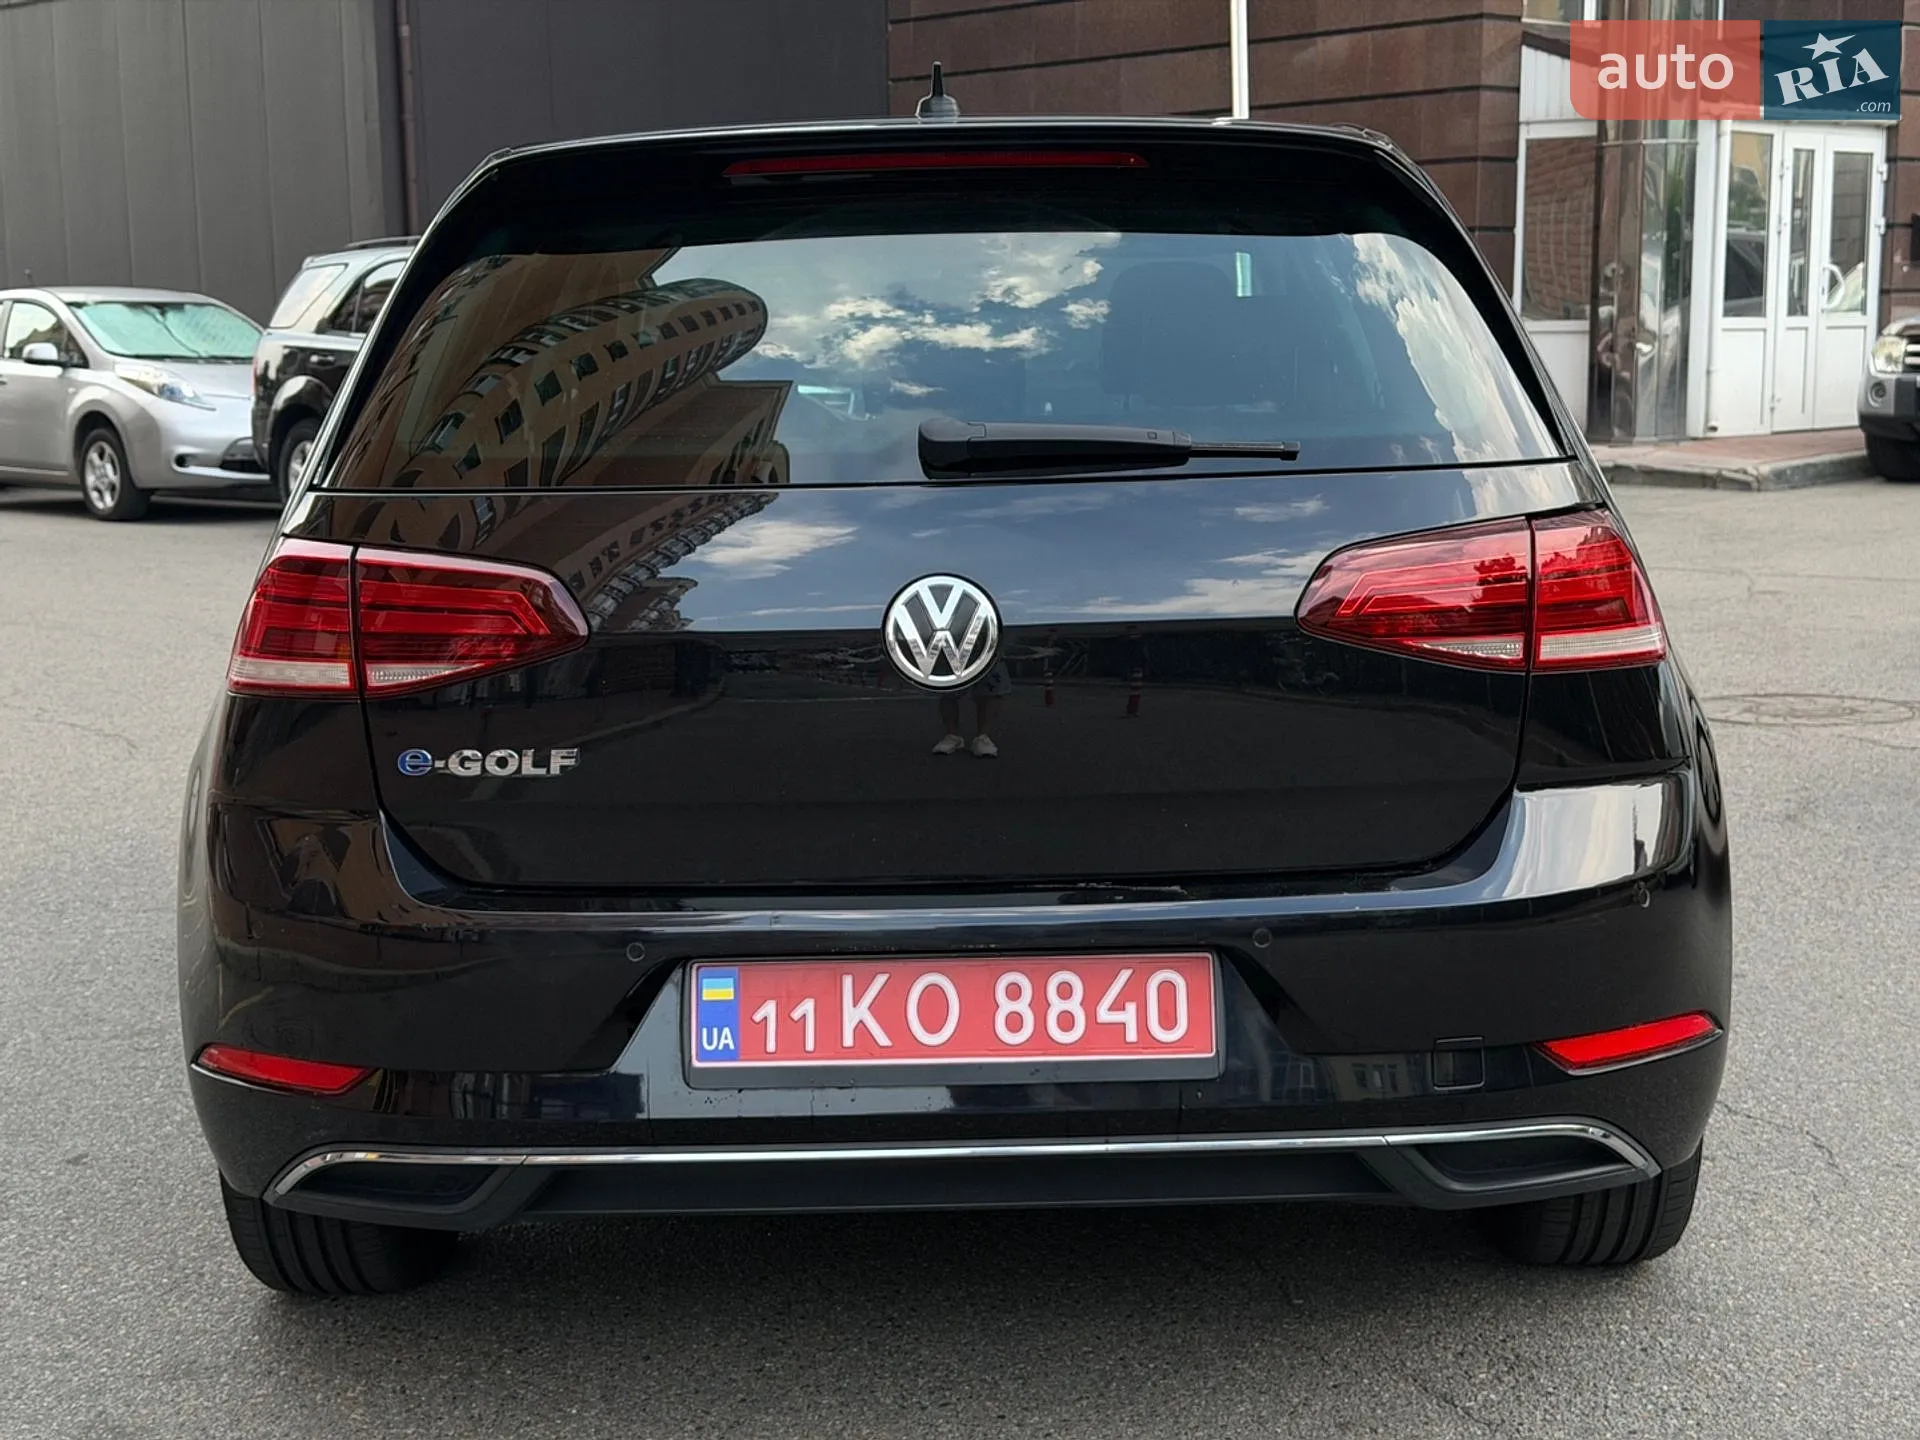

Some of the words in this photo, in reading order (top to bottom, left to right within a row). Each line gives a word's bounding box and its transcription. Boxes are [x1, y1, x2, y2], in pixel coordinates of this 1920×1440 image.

[397, 748, 580, 776] e-GOLF
[993, 968, 1190, 1045] 8840
[702, 1027, 735, 1051] UA
